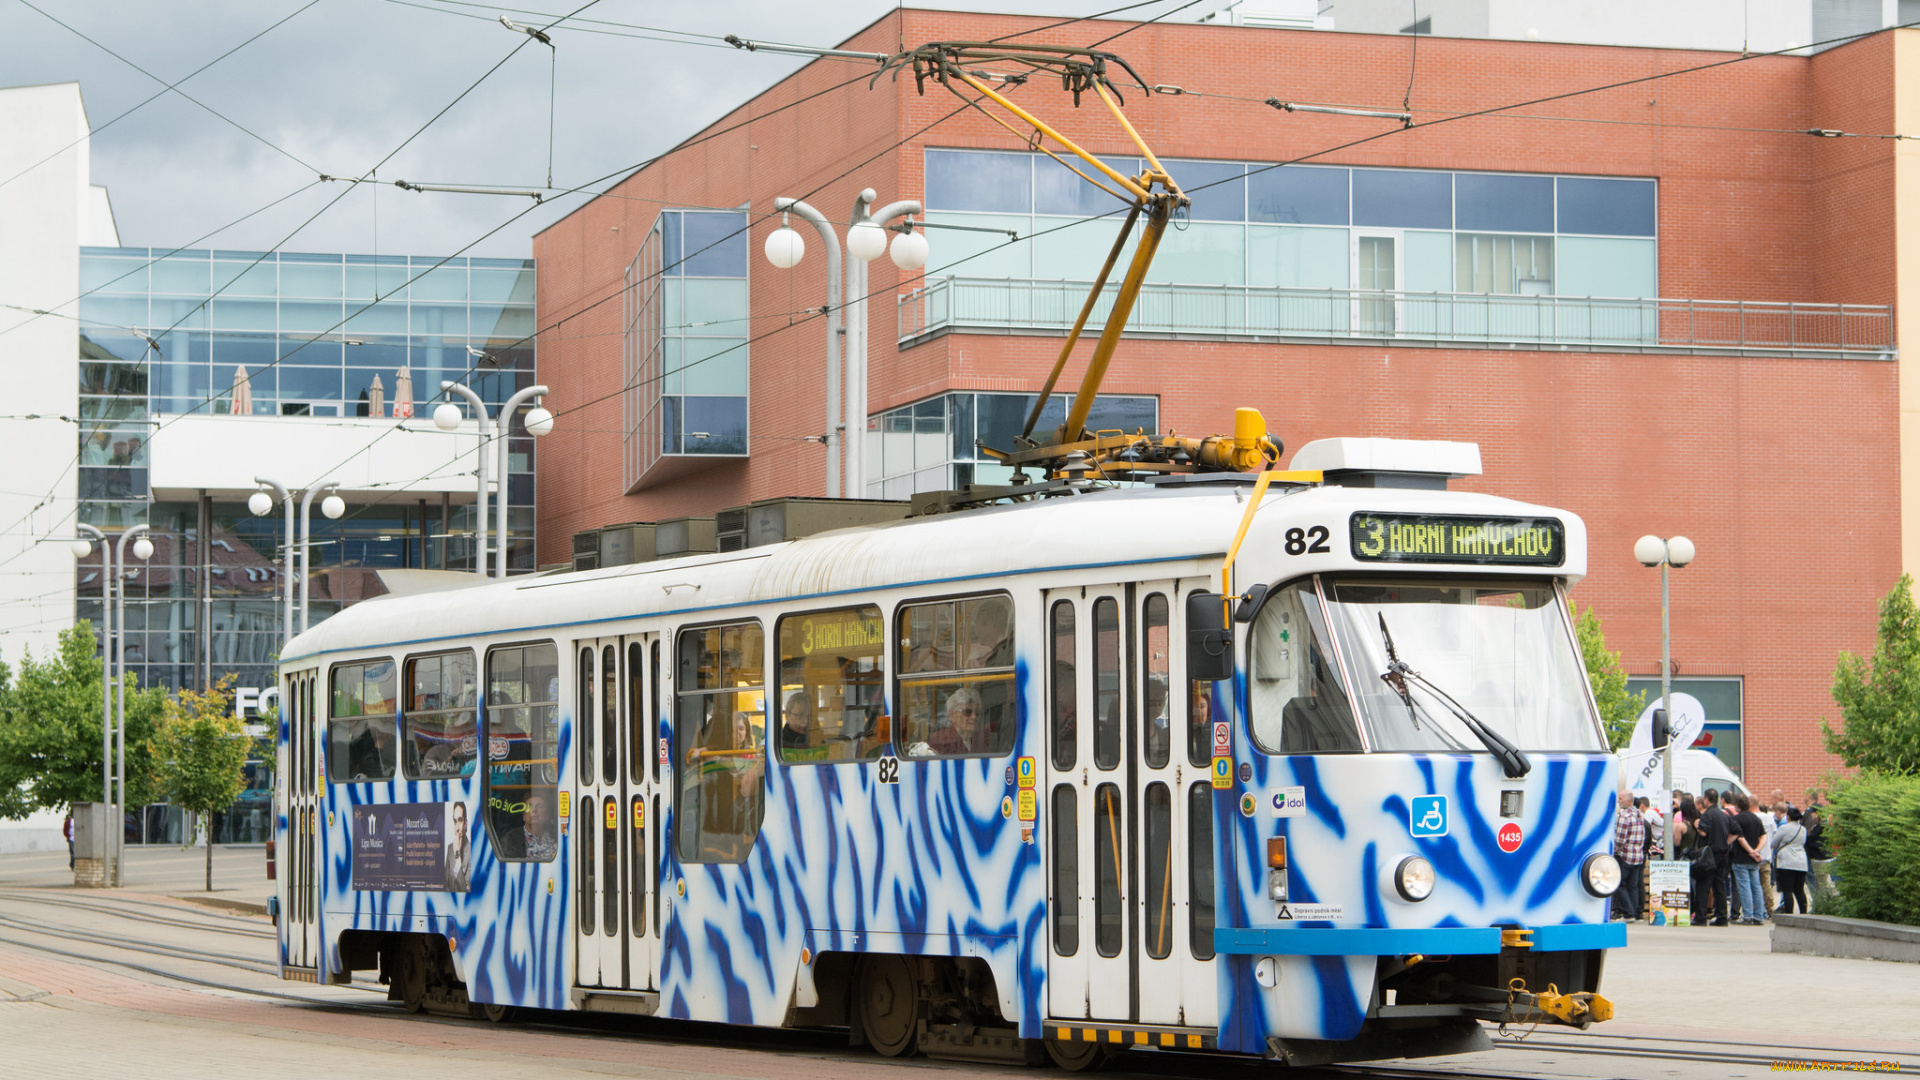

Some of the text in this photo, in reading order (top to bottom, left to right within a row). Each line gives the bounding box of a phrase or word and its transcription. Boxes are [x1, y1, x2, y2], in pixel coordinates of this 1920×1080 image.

[1284, 525, 1330, 555] 82
[1359, 518, 1552, 556] 3 HORNÍ HANYCHOV
[802, 619, 814, 654] 3
[815, 617, 842, 650] HORNÍ
[879, 758, 899, 783] 82
[1287, 798, 1304, 808] idol
[1501, 832, 1521, 843] 1435
